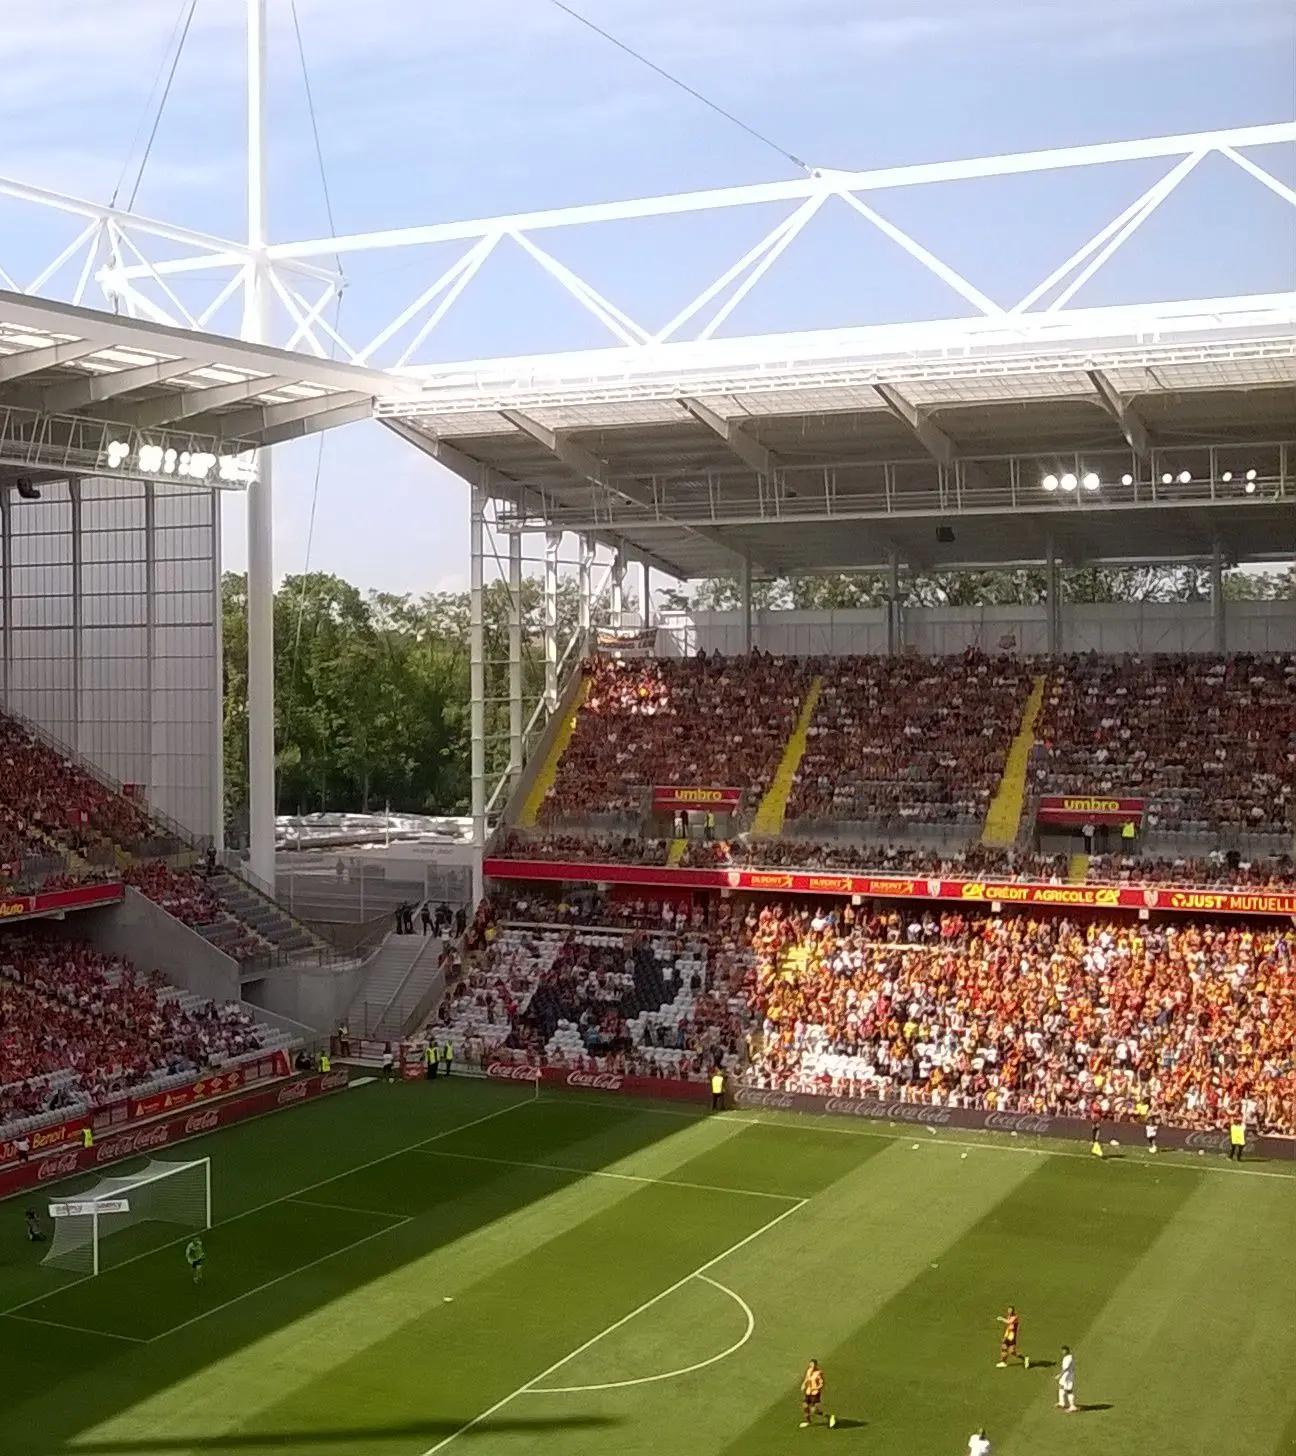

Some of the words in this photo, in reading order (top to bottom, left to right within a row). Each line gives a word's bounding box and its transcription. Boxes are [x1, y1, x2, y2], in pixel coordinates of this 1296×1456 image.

[675, 788, 722, 800] umbro
[1064, 798, 1120, 810] umbro
[1033, 889, 1094, 903] AGRICOLE
[1230, 896, 1296, 912] MUTUELL
